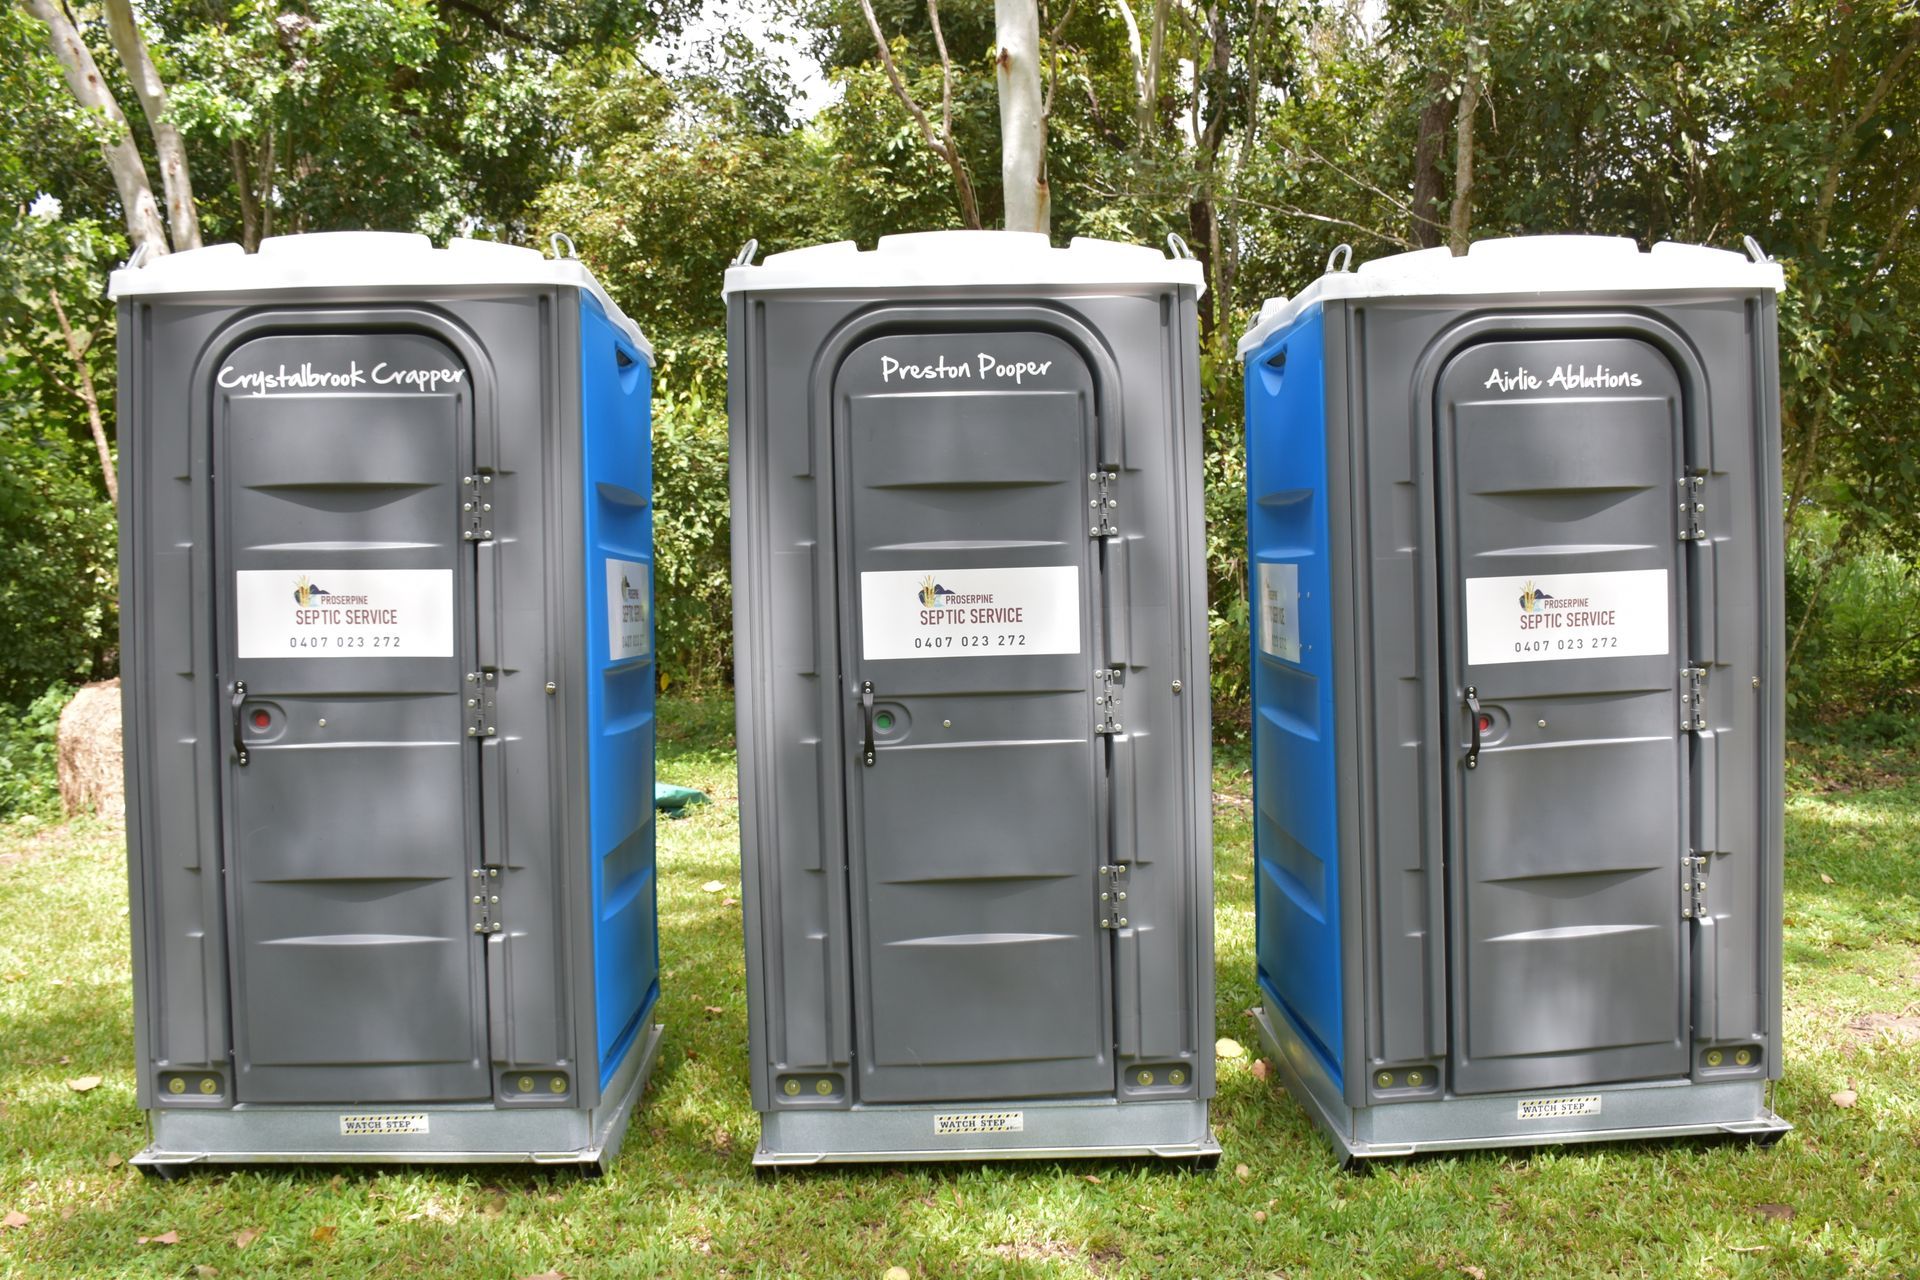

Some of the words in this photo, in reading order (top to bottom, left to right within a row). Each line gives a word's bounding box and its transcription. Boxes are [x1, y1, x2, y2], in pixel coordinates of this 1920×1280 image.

[881, 355, 971, 383] Preston
[977, 352, 1052, 385] Pooper
[217, 360, 366, 396] Crystalbrook
[371, 362, 466, 392] Crapper
[1483, 367, 1542, 393] Airlie
[1547, 364, 1643, 391] Ablutions
[320, 595, 369, 605] PROSERPINE
[945, 594, 994, 605] PROSERPINE
[1544, 598, 1589, 609] PROSERPINE
[295, 609, 341, 625] SEPTIC
[345, 609, 398, 625] SERVICE
[920, 608, 966, 626] SEPTIC
[970, 607, 1023, 624] SERVICE
[1519, 612, 1562, 630] SEPTIC
[1566, 610, 1615, 627] SERVICE
[289, 636, 328, 647] 0407
[336, 636, 365, 647] 023
[373, 636, 401, 647] 272
[914, 636, 953, 648] 0407
[961, 635, 990, 647] 023
[998, 634, 1026, 646] 272
[1514, 640, 1550, 652] 0407
[1557, 639, 1584, 650] 023
[1591, 637, 1618, 649] 272
[1522, 1105, 1557, 1113] WATCH
[1561, 1103, 1585, 1111] STEP
[345, 1121, 382, 1129] WATCH
[386, 1120, 411, 1128] STEP
[940, 1120, 976, 1129] WATCH
[980, 1119, 1006, 1127] STEP
